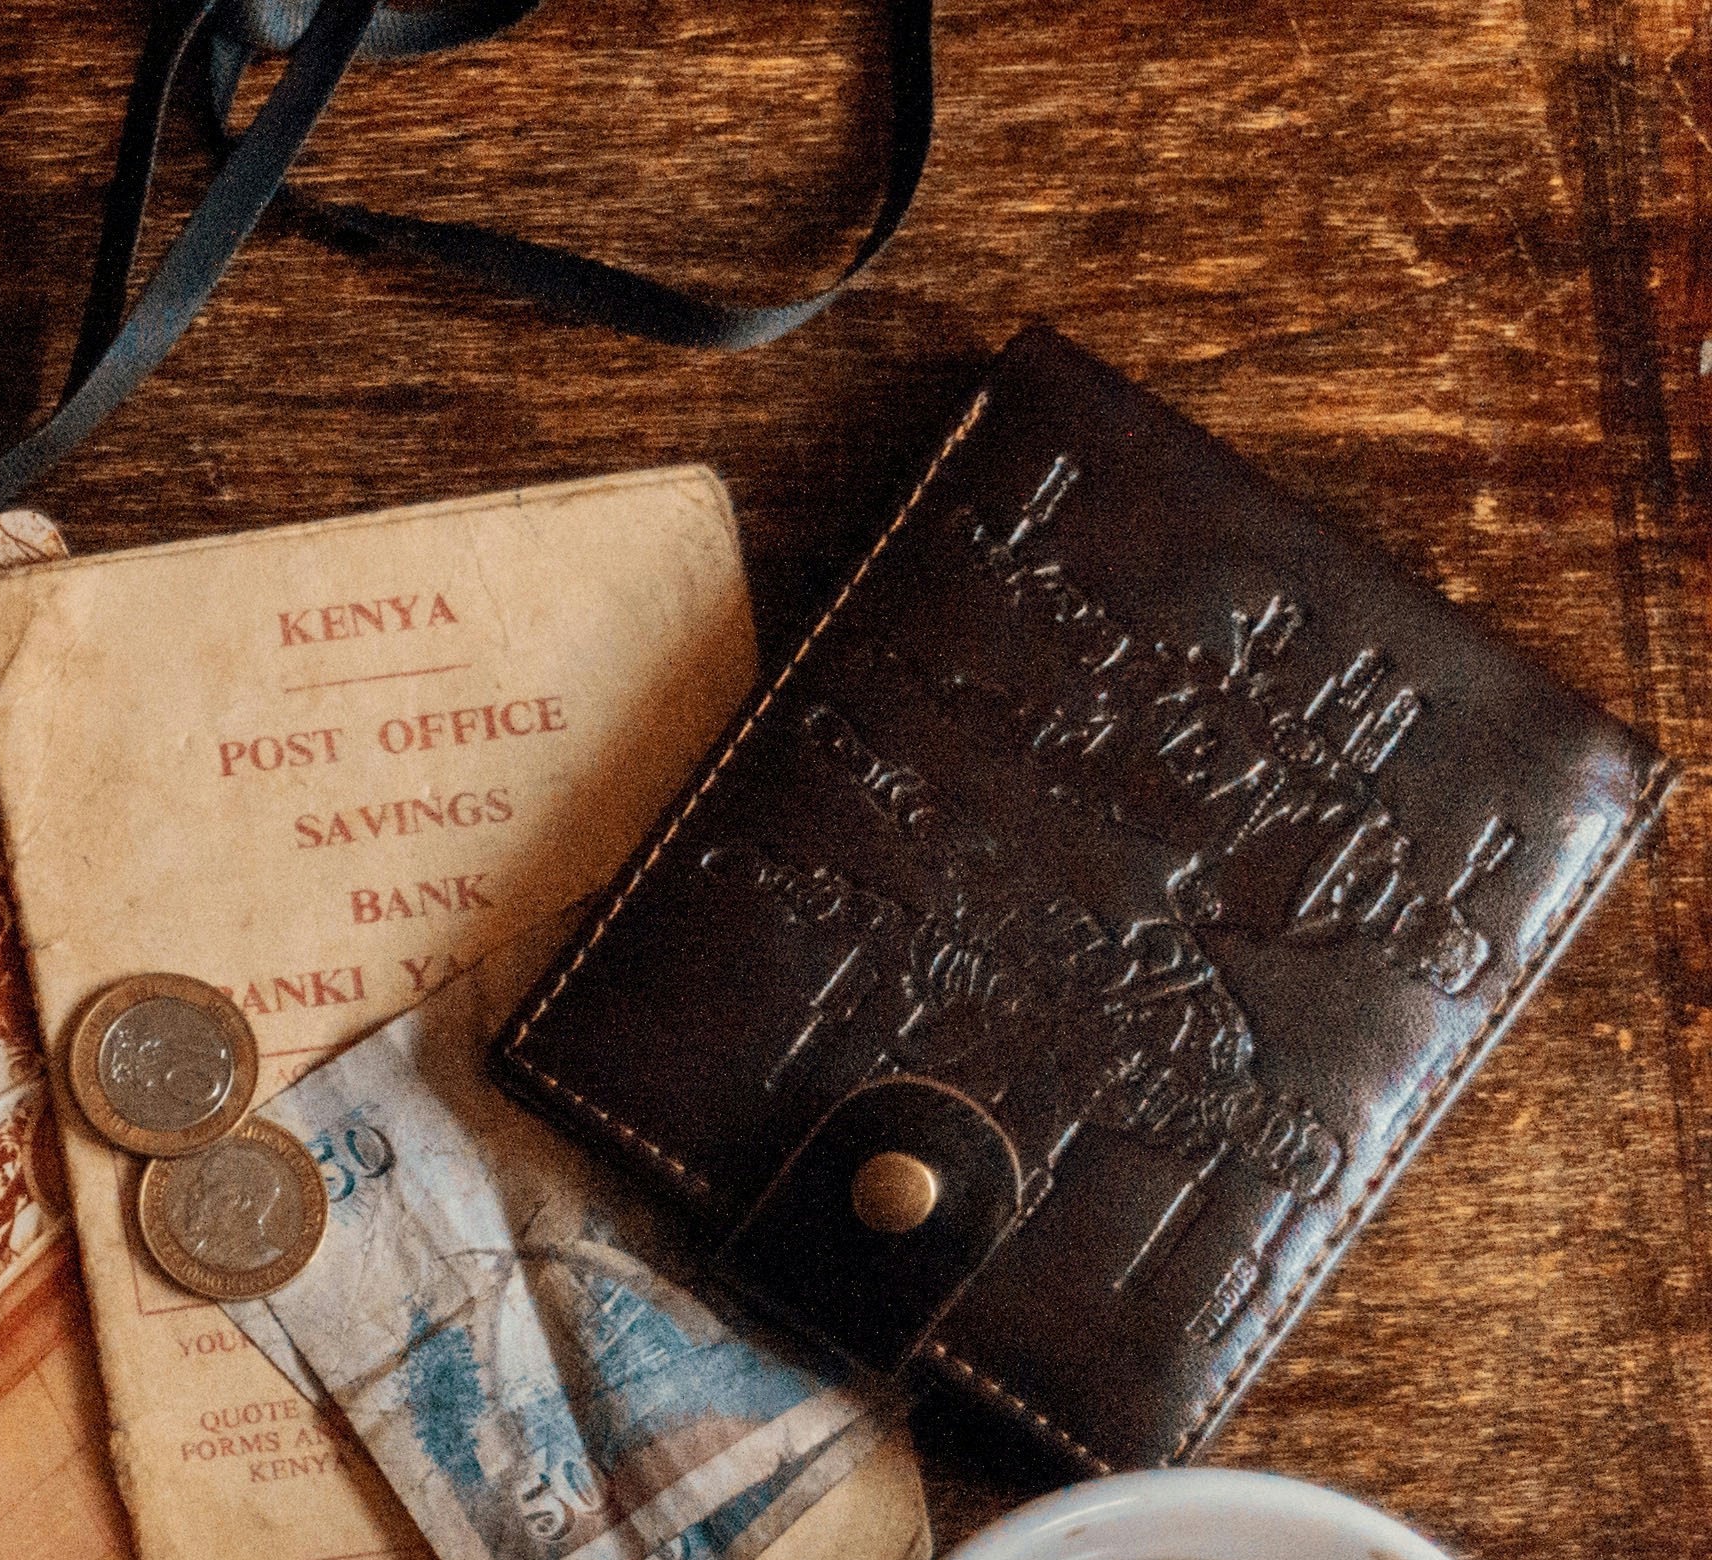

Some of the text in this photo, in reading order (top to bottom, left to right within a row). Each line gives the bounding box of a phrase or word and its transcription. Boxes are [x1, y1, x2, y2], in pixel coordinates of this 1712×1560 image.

[278, 590, 460, 648] KENYA
[218, 696, 568, 777] POST OFFICE
[295, 787, 514, 850] SAVINGS
[350, 872, 495, 926] BANK
[307, 1124, 396, 1202] 50
[180, 1431, 281, 1463] FORMS
[200, 1400, 300, 1434] QUOTE
[517, 1450, 602, 1540] 50
